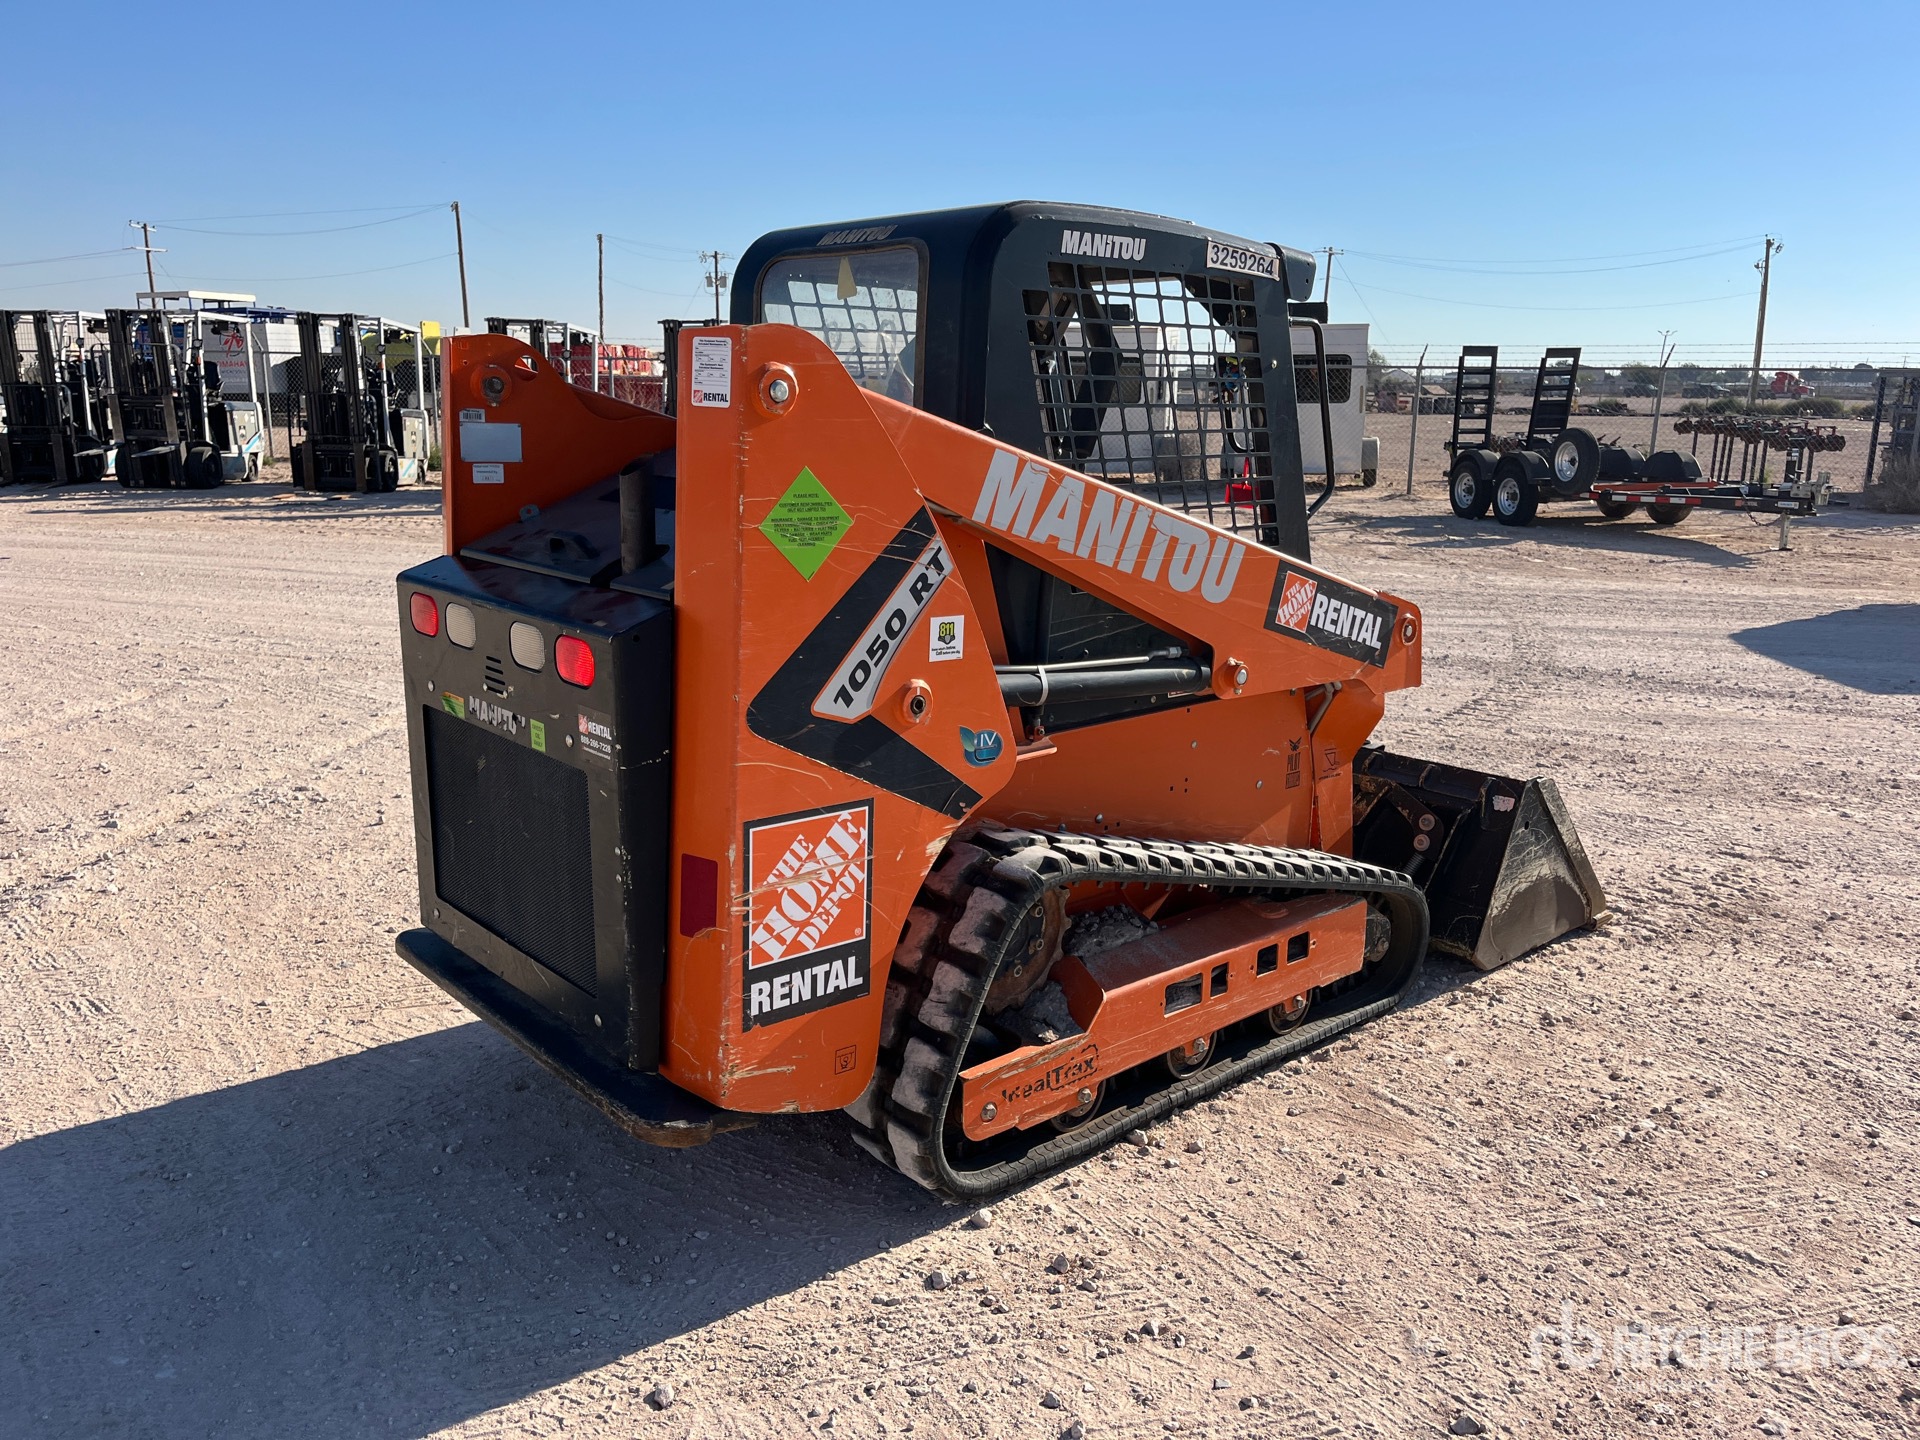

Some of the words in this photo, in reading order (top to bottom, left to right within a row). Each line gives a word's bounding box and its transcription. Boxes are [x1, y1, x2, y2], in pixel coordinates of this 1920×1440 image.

[816, 224, 899, 247] MANITOU
[1061, 229, 1147, 261] MANITOU
[1210, 244, 1274, 276] 3259264
[703, 392, 729, 403] RENTAL
[972, 448, 1246, 604] MANITOU
[1278, 580, 1313, 625] HOME
[1285, 581, 1301, 600] THE
[833, 608, 907, 709] 1050
[908, 545, 945, 607] RT
[939, 622, 955, 636] 811
[1310, 593, 1383, 650] RENTAL
[588, 721, 612, 741] RENTAL
[980, 732, 997, 747] IV
[763, 834, 814, 894] THE
[752, 811, 867, 960] HOME
[797, 861, 866, 952] DEPOT
[751, 956, 864, 1017] RENTAL
